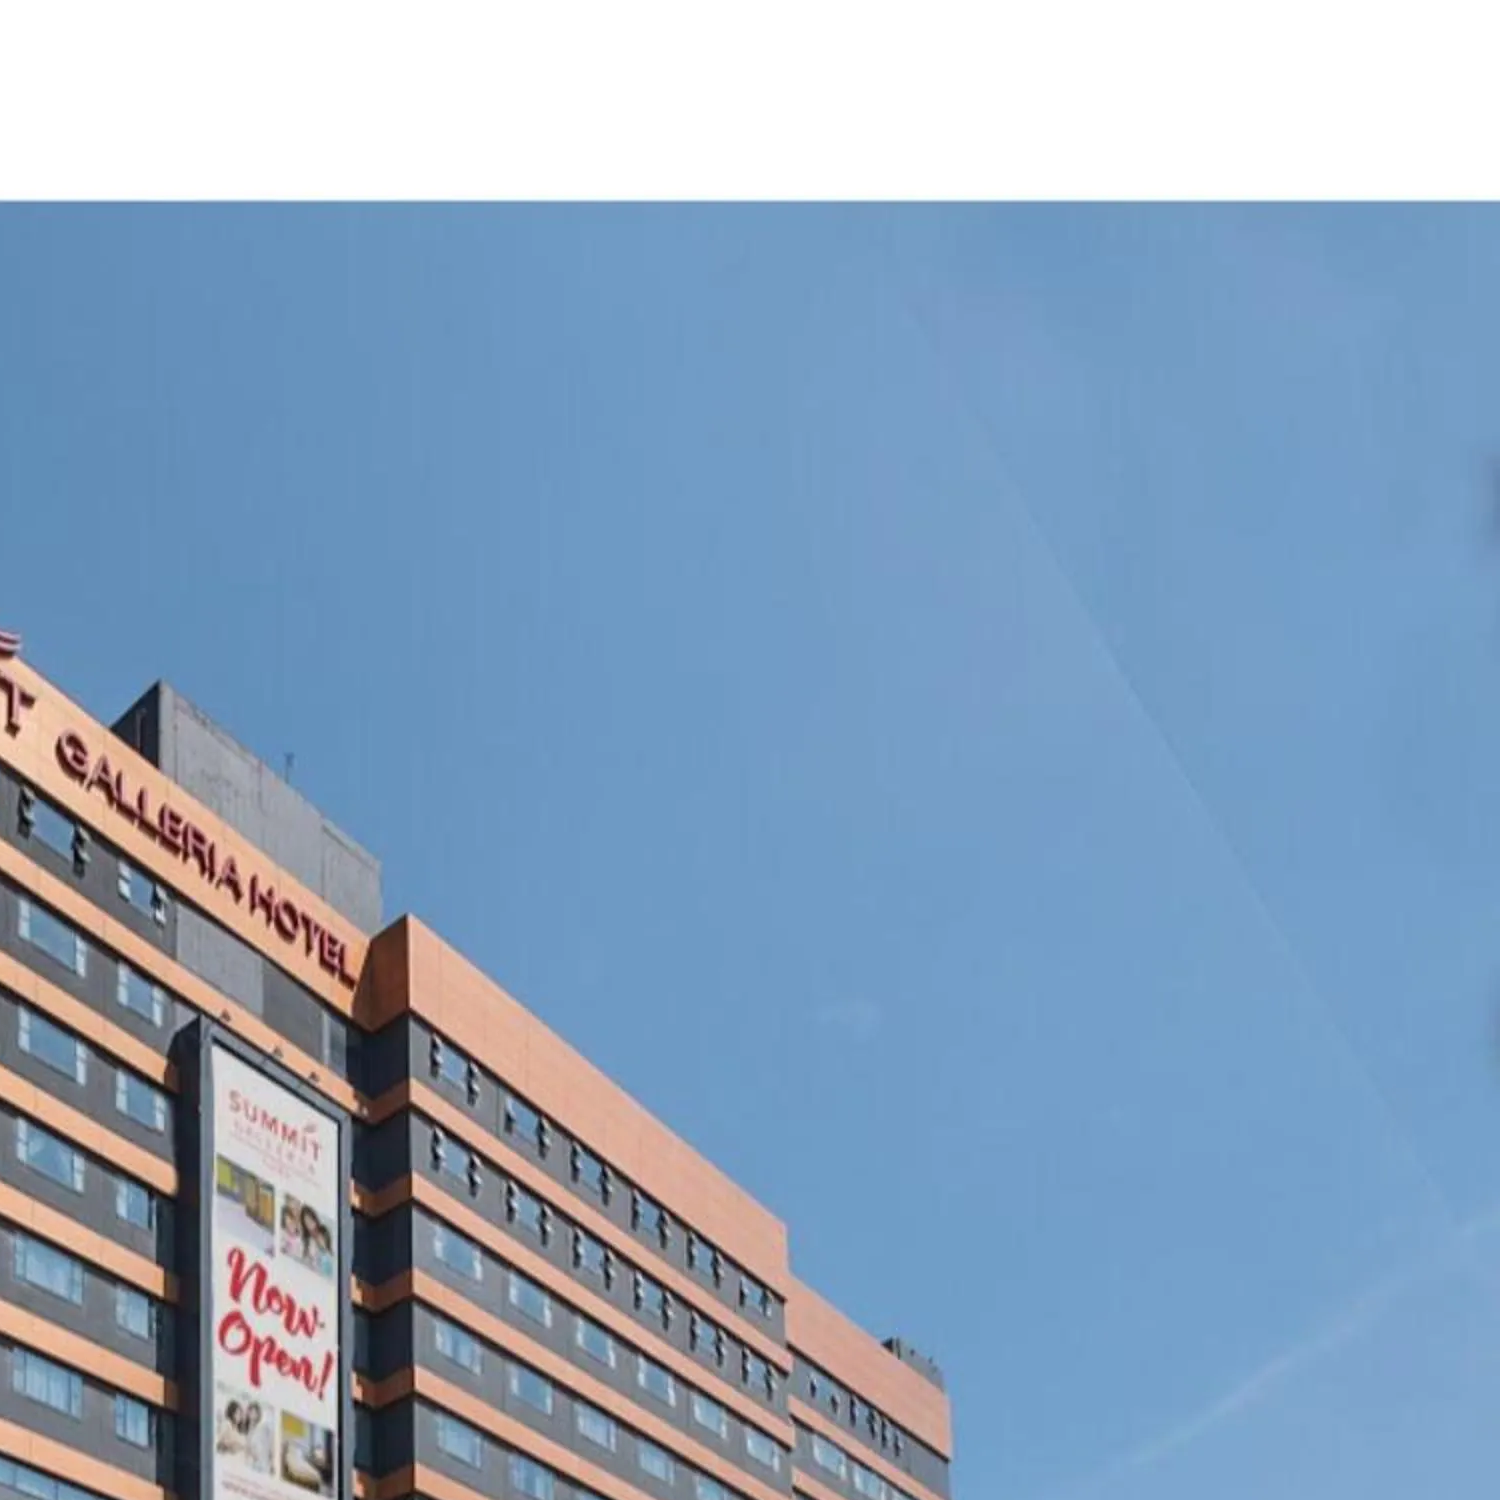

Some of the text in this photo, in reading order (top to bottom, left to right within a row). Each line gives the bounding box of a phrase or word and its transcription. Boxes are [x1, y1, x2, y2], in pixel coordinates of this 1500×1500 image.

[55, 726, 243, 905] GALLERIA
[247, 873, 358, 990] HOTEL
[228, 1089, 324, 1162] SUMMIT
[217, 1309, 334, 1402] Open!
